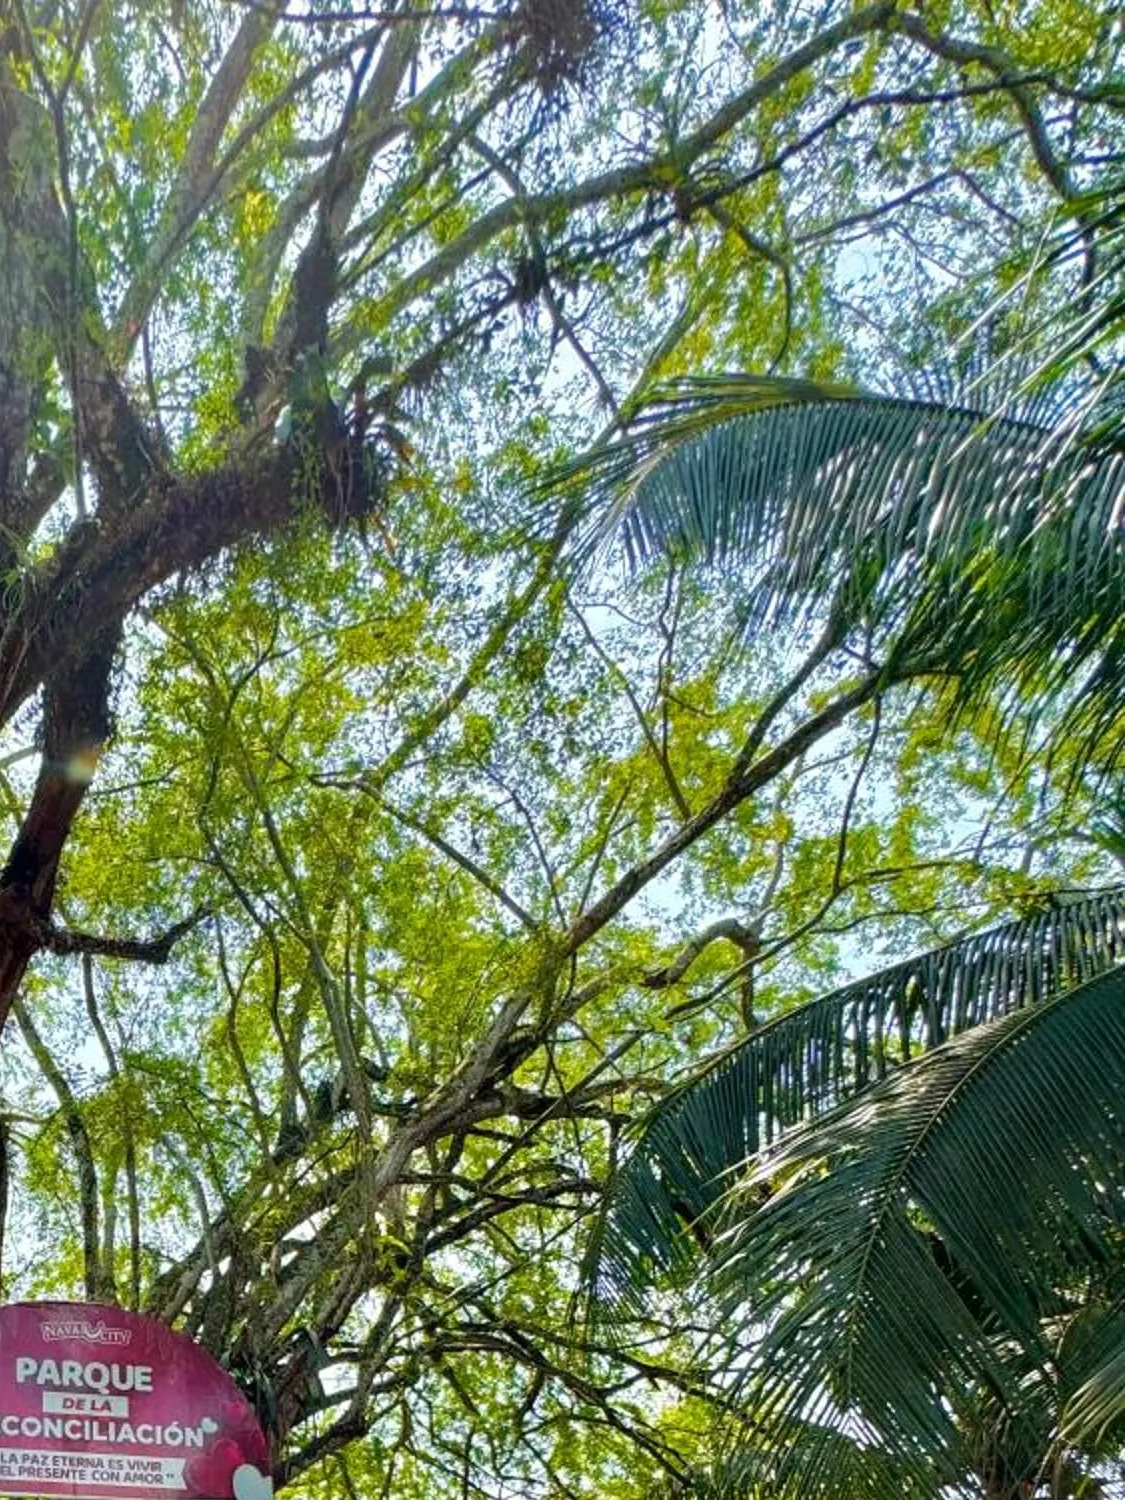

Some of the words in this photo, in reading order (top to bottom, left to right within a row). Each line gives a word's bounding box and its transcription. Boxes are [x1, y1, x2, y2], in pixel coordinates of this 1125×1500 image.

[100, 1329, 130, 1344] CITY
[16, 1357, 154, 1394] PARQUE
[62, 1397, 85, 1411] DE
[90, 1399, 112, 1412] LA
[22, 1453, 50, 1467] PAZ
[52, 1455, 104, 1469] ETERNA
[108, 1458, 124, 1471] ES
[127, 1459, 162, 1473] VIVIR
[0, 1465, 16, 1477] EL
[18, 1465, 87, 1481] PRESENTE
[92, 1469, 120, 1482] CON
